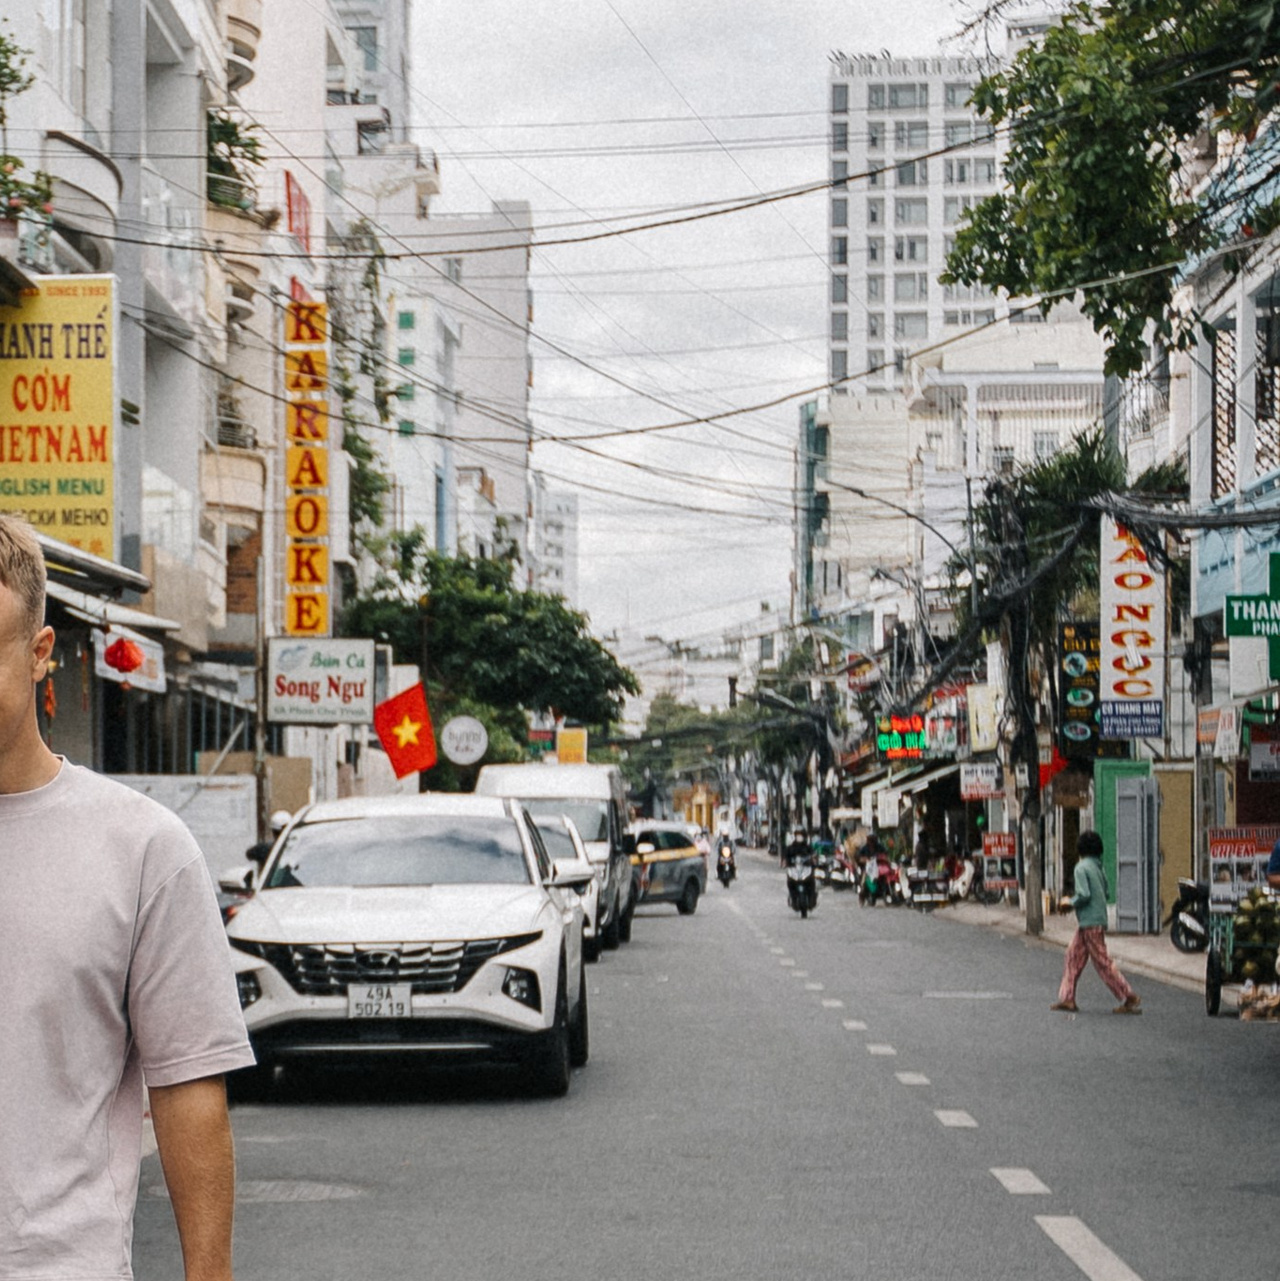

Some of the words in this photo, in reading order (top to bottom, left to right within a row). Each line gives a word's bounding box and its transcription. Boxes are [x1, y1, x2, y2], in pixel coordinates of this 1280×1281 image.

[291, 306, 322, 632] KARAOKE
[57, 477, 105, 496] MENU
[61, 507, 110, 527] МЕНЮ
[1252, 621, 1280, 636] PHA
[275, 674, 320, 704] Song
[327, 674, 367, 704] Ngư
[366, 986, 394, 1001] 49A
[355, 1002, 405, 1016] 502.19
